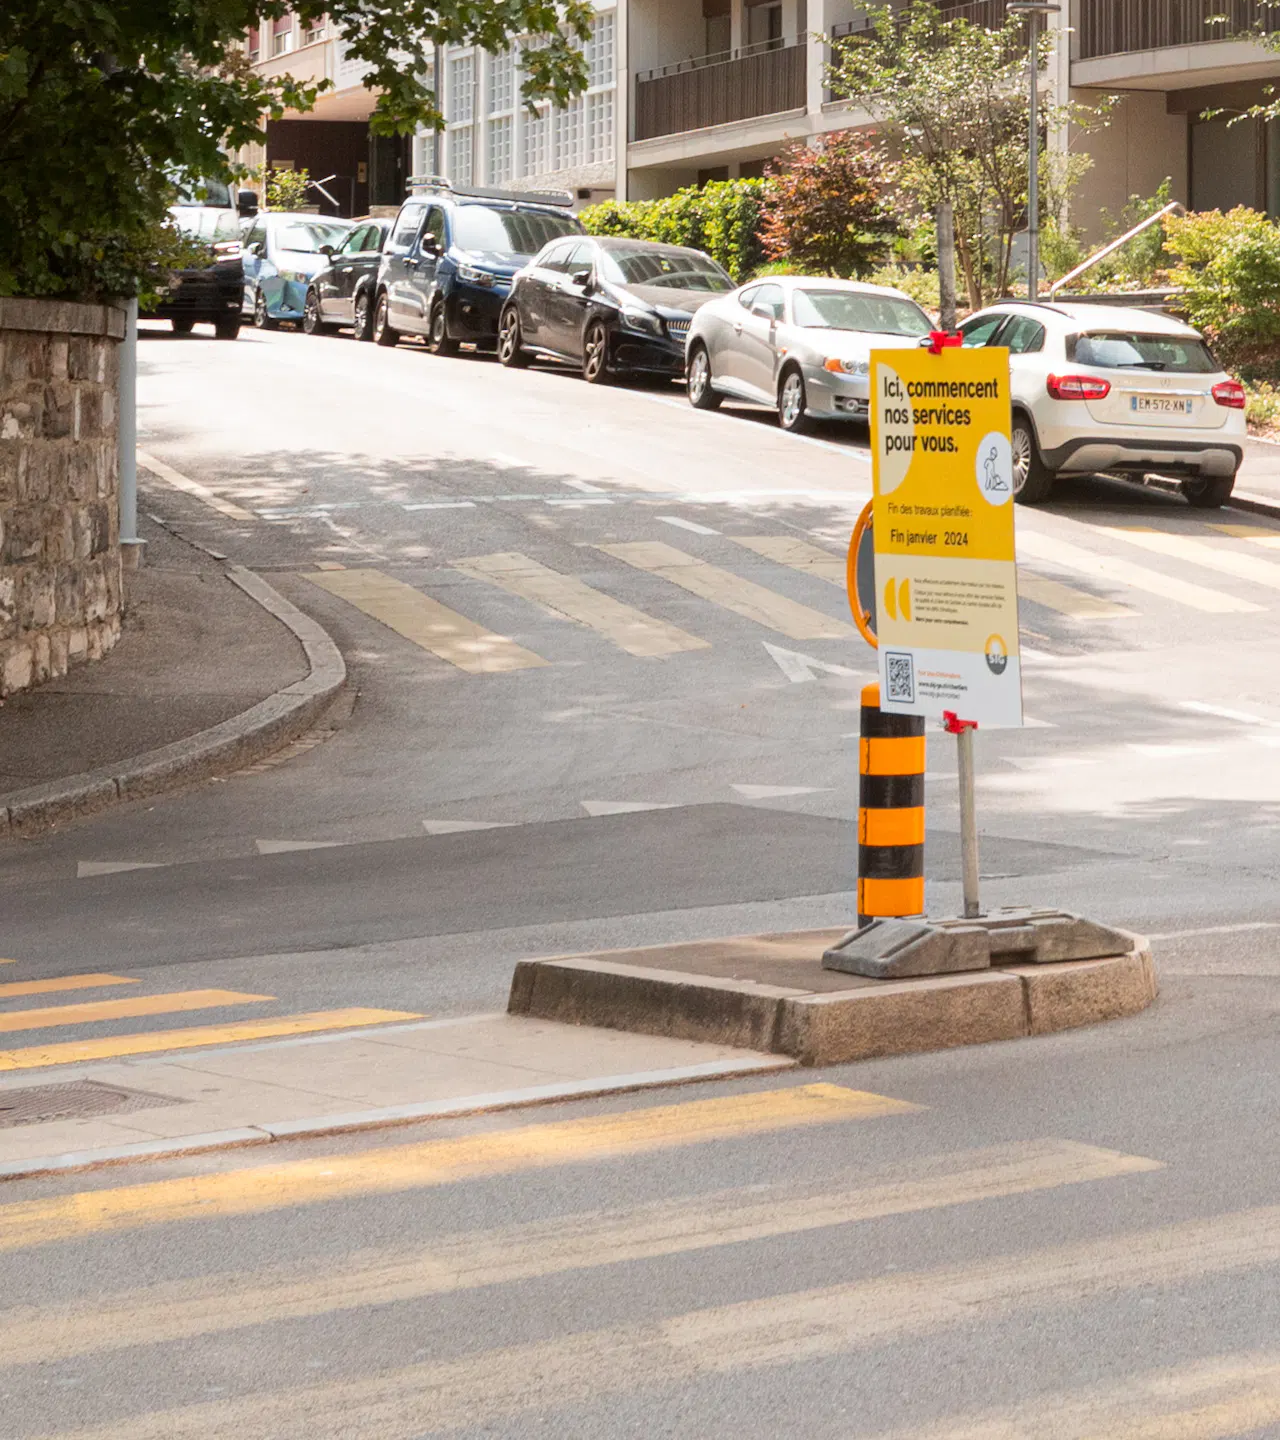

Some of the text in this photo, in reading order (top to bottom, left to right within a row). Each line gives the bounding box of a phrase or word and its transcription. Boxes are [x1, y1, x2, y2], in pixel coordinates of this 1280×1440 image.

[884, 376, 999, 401] Ici, commencent
[884, 404, 971, 425] nos services
[885, 434, 959, 456] pour vous.
[888, 502, 899, 514] Fin
[900, 502, 913, 515] des
[914, 504, 939, 516] travaux
[891, 529, 969, 547] Fin janvier 2024
